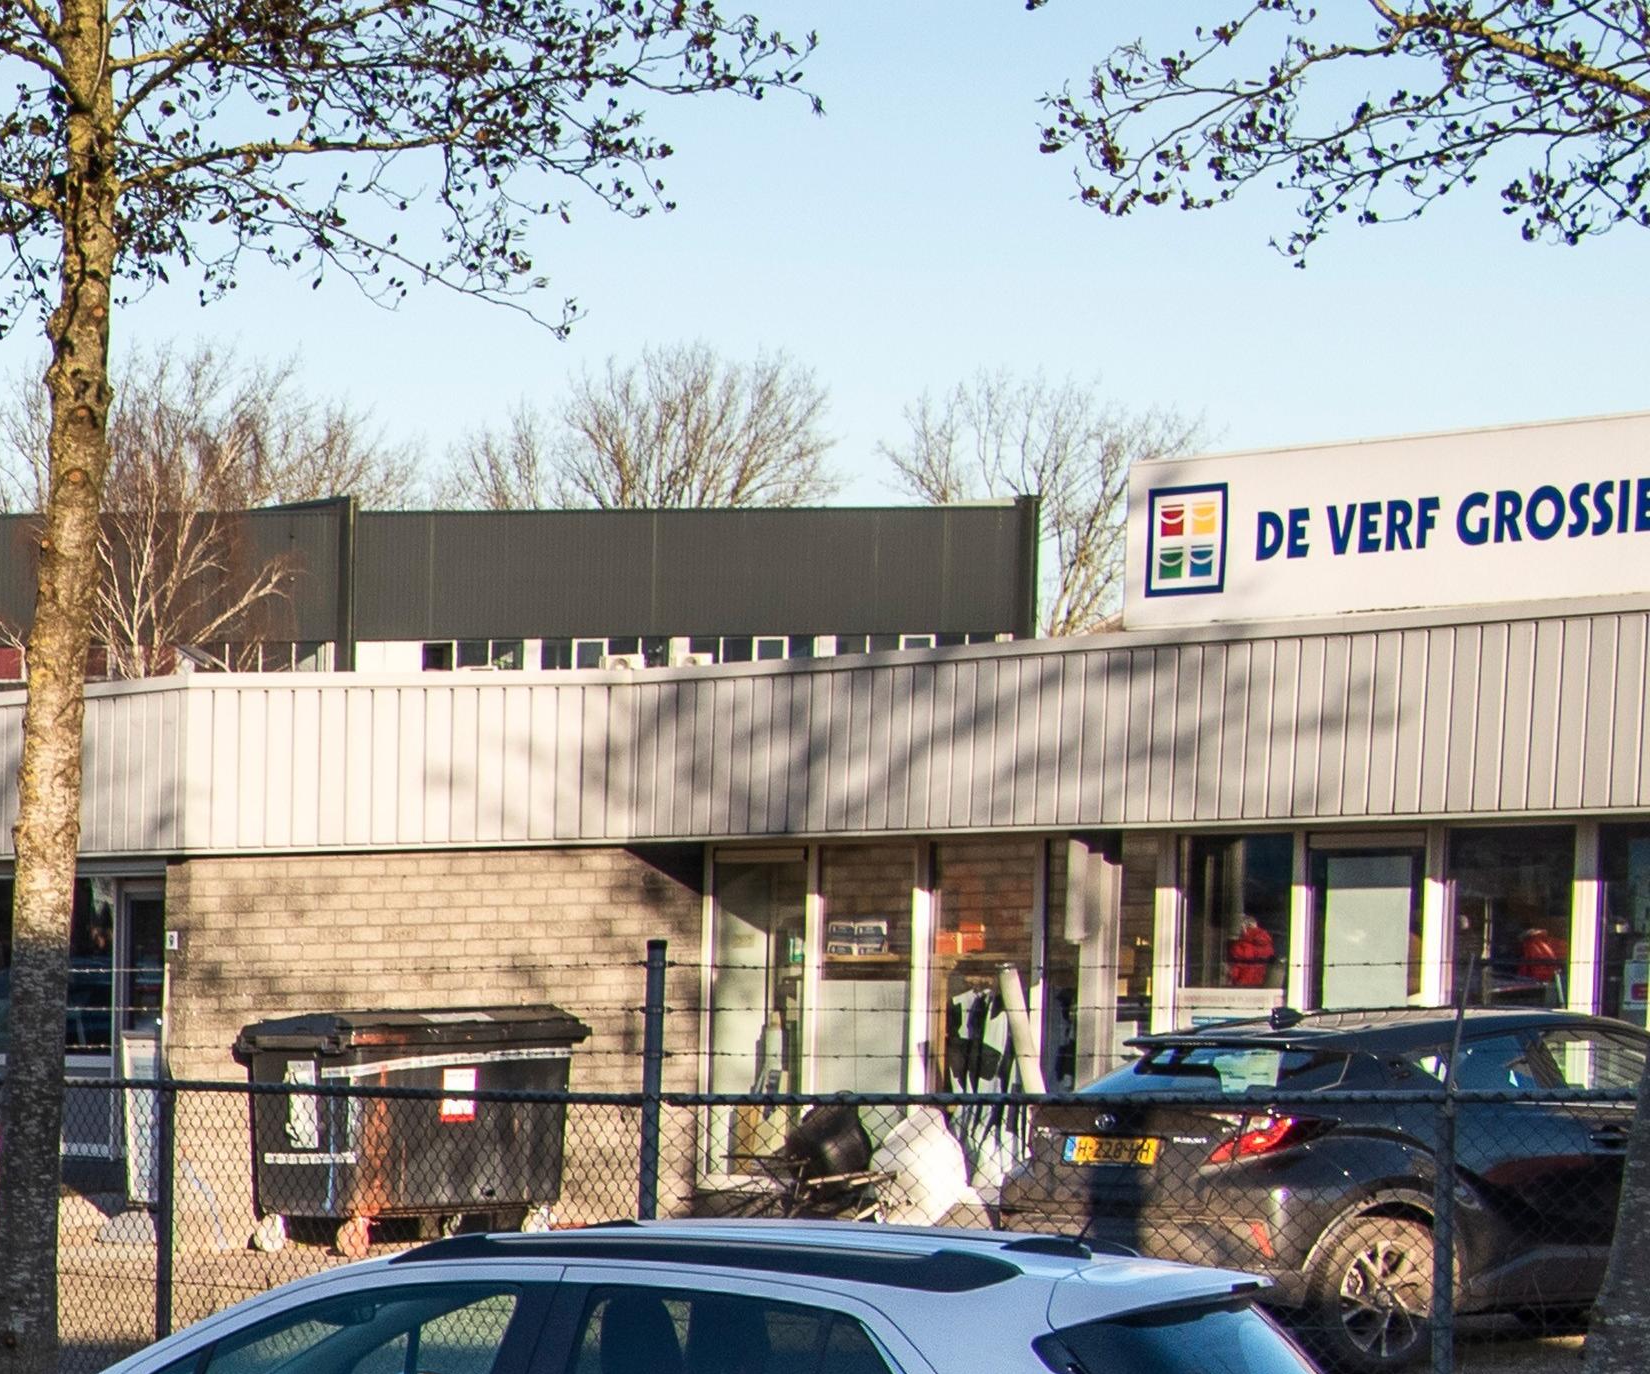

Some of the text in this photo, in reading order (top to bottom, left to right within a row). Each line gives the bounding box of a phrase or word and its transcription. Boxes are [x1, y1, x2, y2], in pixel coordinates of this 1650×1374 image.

[1255, 477, 1650, 562] DE VERF GROSSIE
